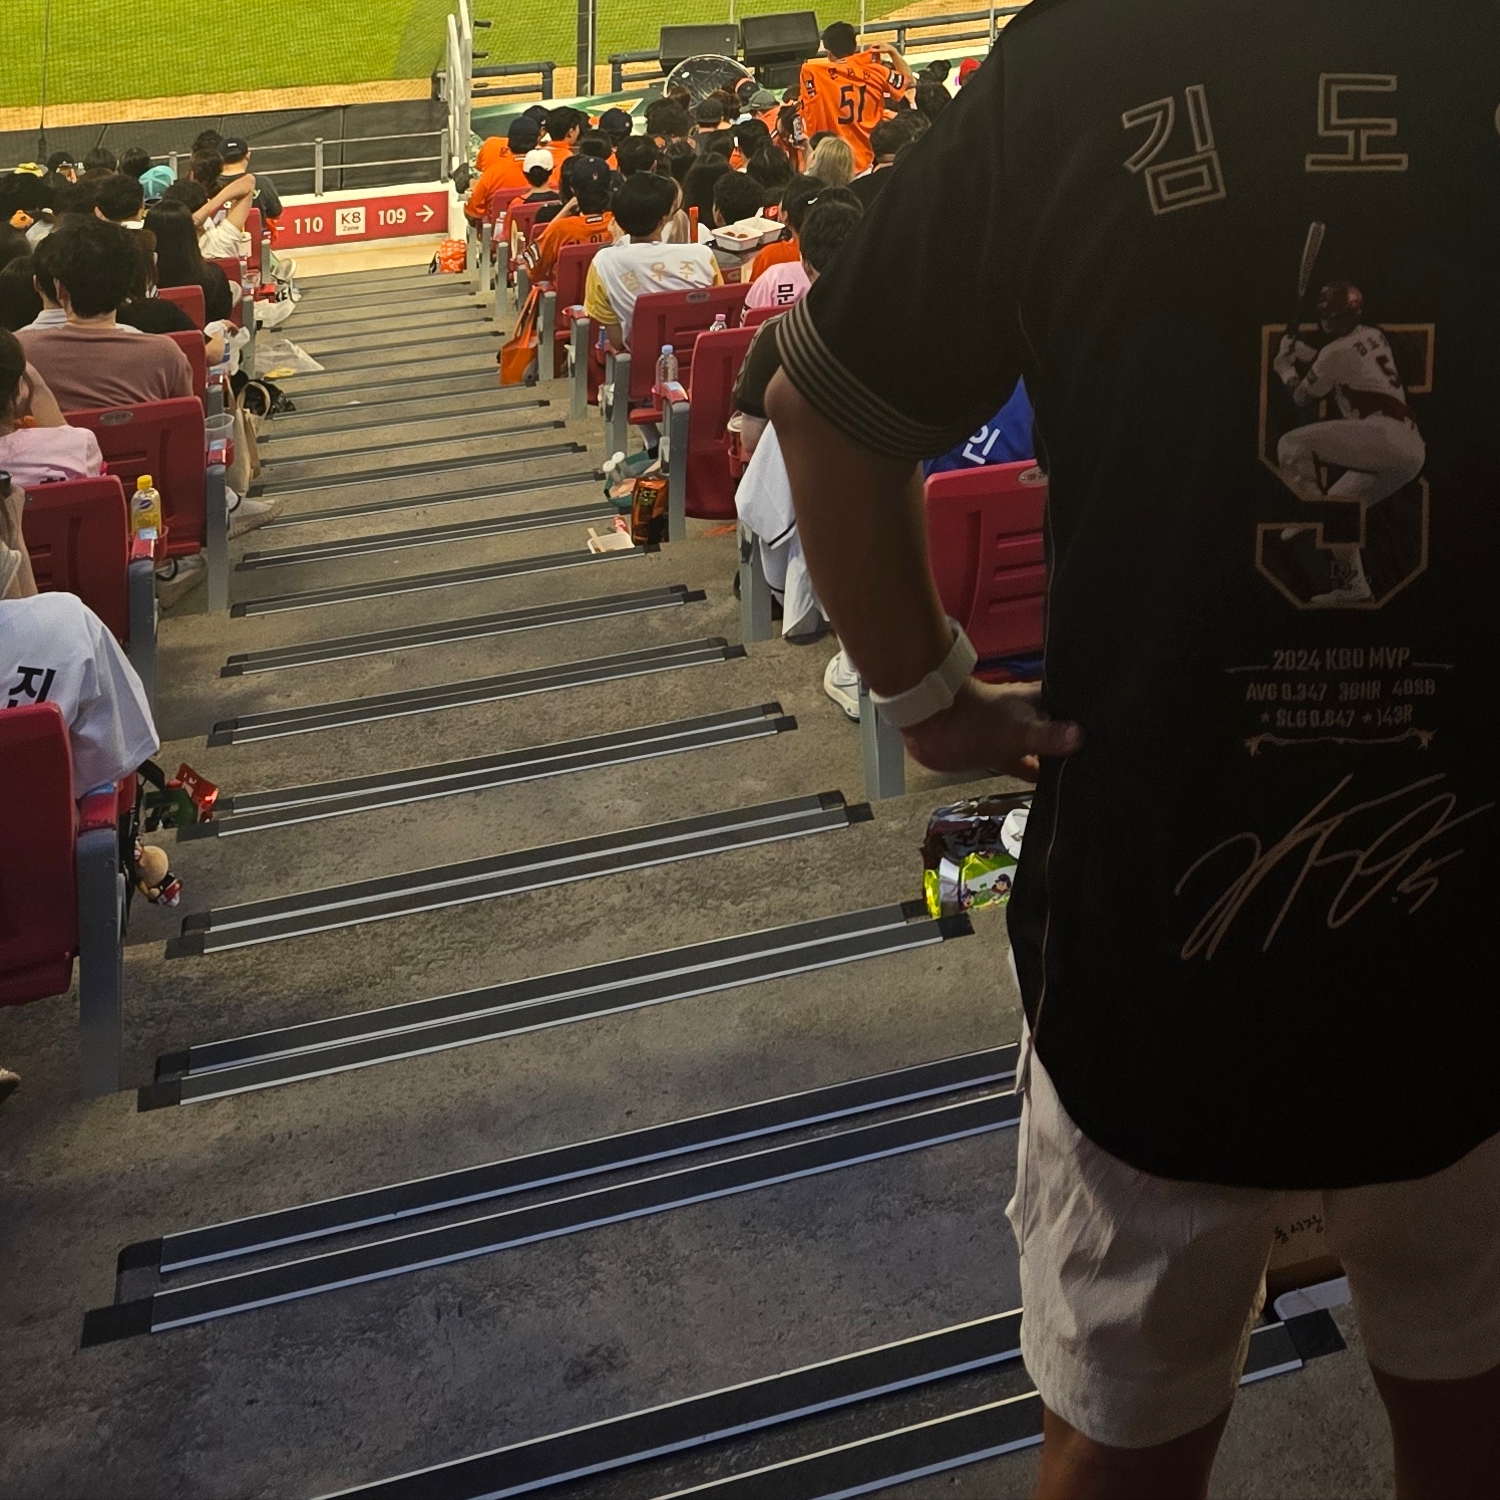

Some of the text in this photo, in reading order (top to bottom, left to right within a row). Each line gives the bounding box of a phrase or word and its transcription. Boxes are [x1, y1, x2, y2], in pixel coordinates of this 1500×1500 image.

[838, 84, 866, 125] 51
[295, 208, 407, 235] 110 K8 109
[1272, 646, 1411, 672] 2024 KBO MVP
[1246, 682, 1278, 702] AVG
